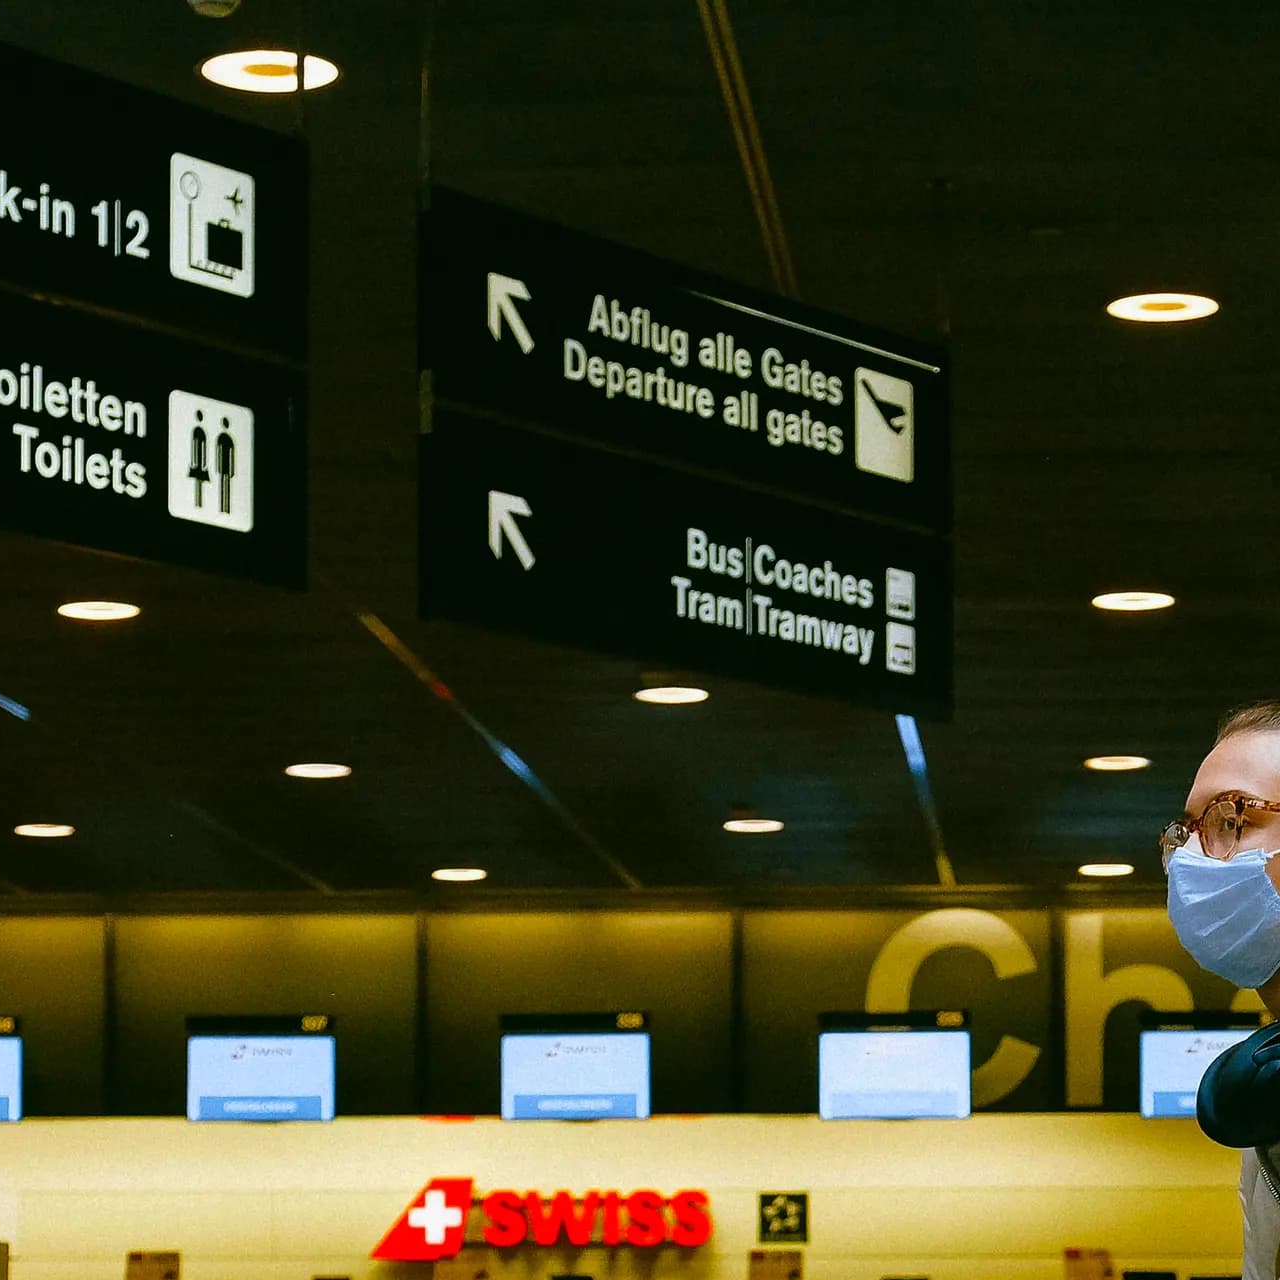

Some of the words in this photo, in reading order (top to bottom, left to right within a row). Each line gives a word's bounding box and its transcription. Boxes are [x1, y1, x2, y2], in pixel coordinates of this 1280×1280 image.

[563, 338, 715, 419] Departure
[723, 390, 759, 432] all
[766, 407, 844, 456] gates
[587, 294, 690, 368] Abflug
[698, 331, 753, 379] alle
[760, 346, 844, 406] Gates
[12, 422, 148, 500] Toilets
[481, 1190, 713, 1247] SWISS
